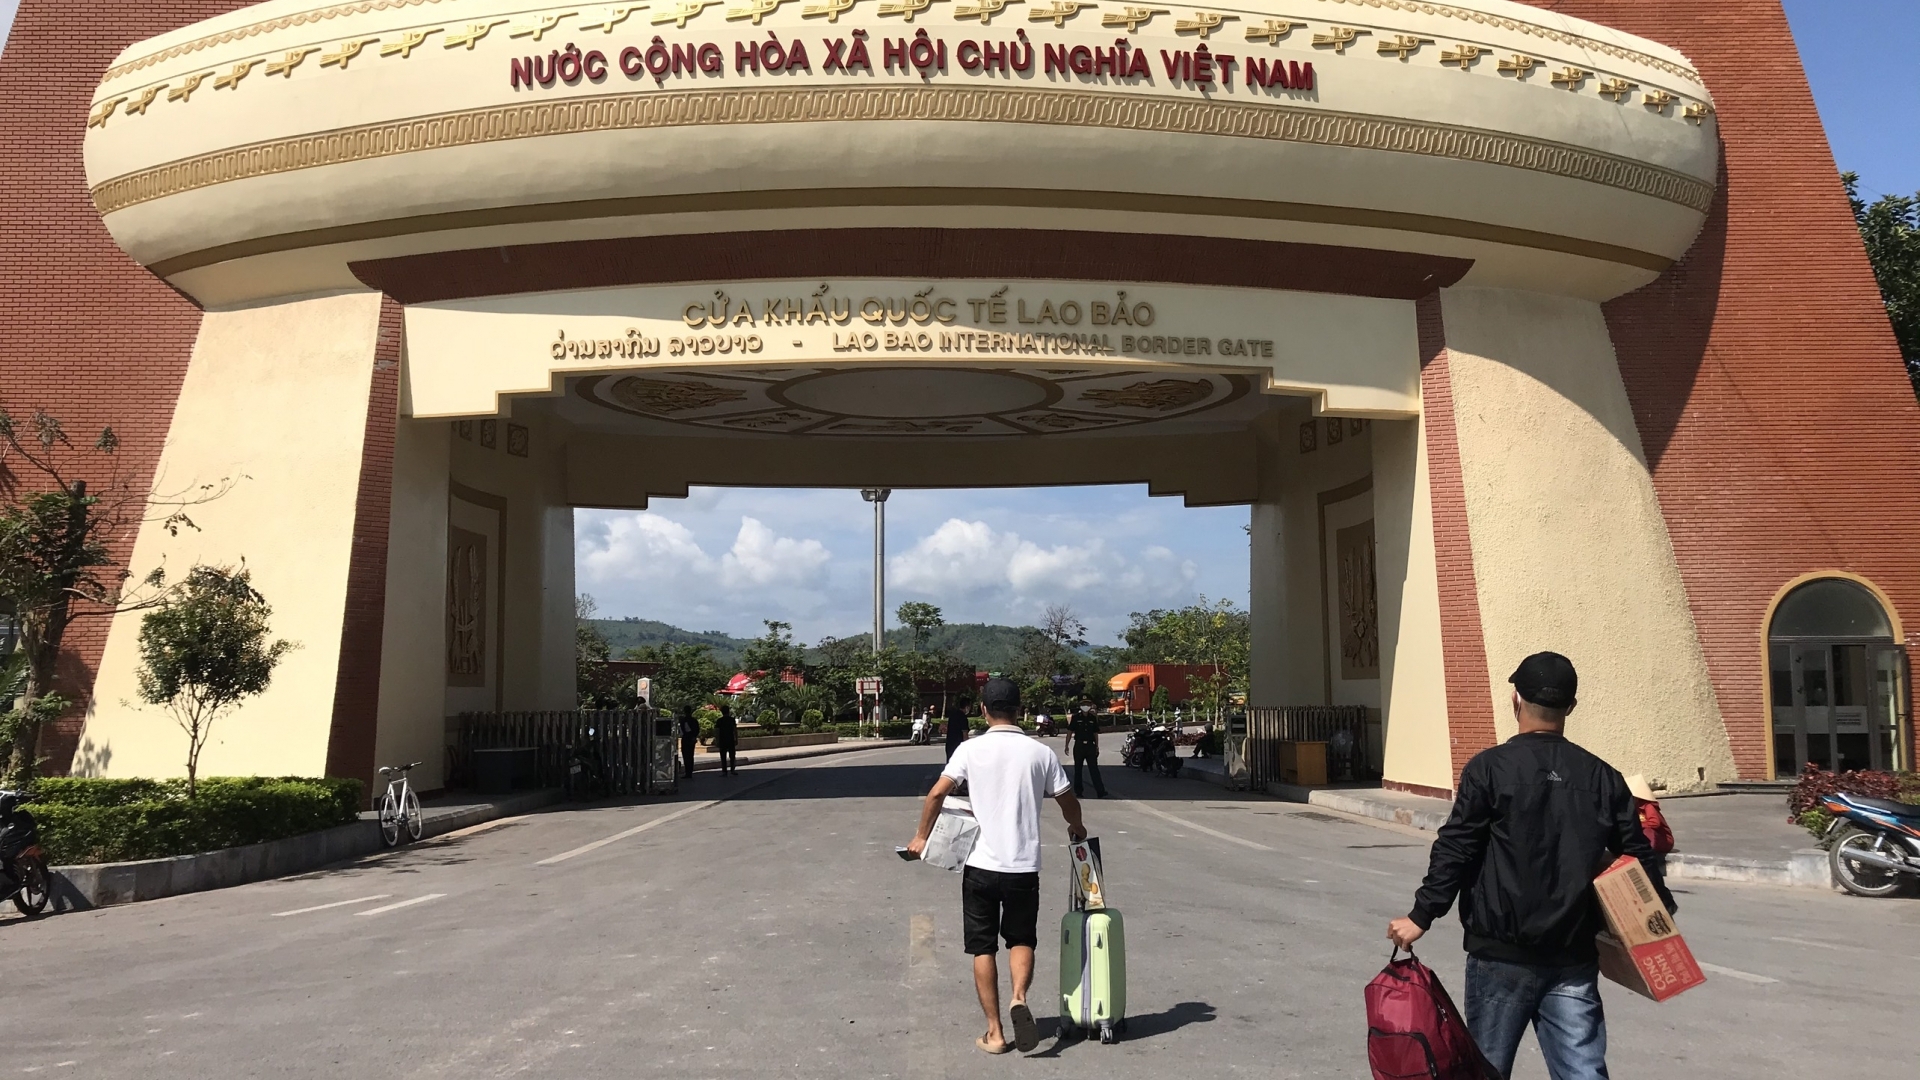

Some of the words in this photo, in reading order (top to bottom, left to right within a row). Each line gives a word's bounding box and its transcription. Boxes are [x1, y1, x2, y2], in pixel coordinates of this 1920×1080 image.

[510, 43, 606, 88] NƯỚC
[619, 35, 721, 84] CỘNG
[735, 30, 810, 72] HÒA
[823, 29, 871, 69] XÃ
[883, 28, 945, 78] HỘI
[956, 29, 1032, 72] CHỦ
[1044, 37, 1151, 78] NGHĨA
[1160, 43, 1235, 91] VIỆT
[1246, 57, 1314, 91] NAM
[682, 289, 754, 327] CỬA
[763, 282, 850, 325] KHẨU
[859, 286, 957, 323] QUỐC
[967, 285, 1009, 324] TẾ
[1017, 298, 1082, 325] LAO
[1091, 290, 1155, 327] BẢO
[832, 331, 878, 350] LAO
[884, 331, 932, 351] BAO
[939, 331, 1115, 353] INTERNATIONAL
[1121, 335, 1212, 355] BORDER
[1217, 338, 1274, 358] GATE
[1643, 956, 1666, 991] CUNG
